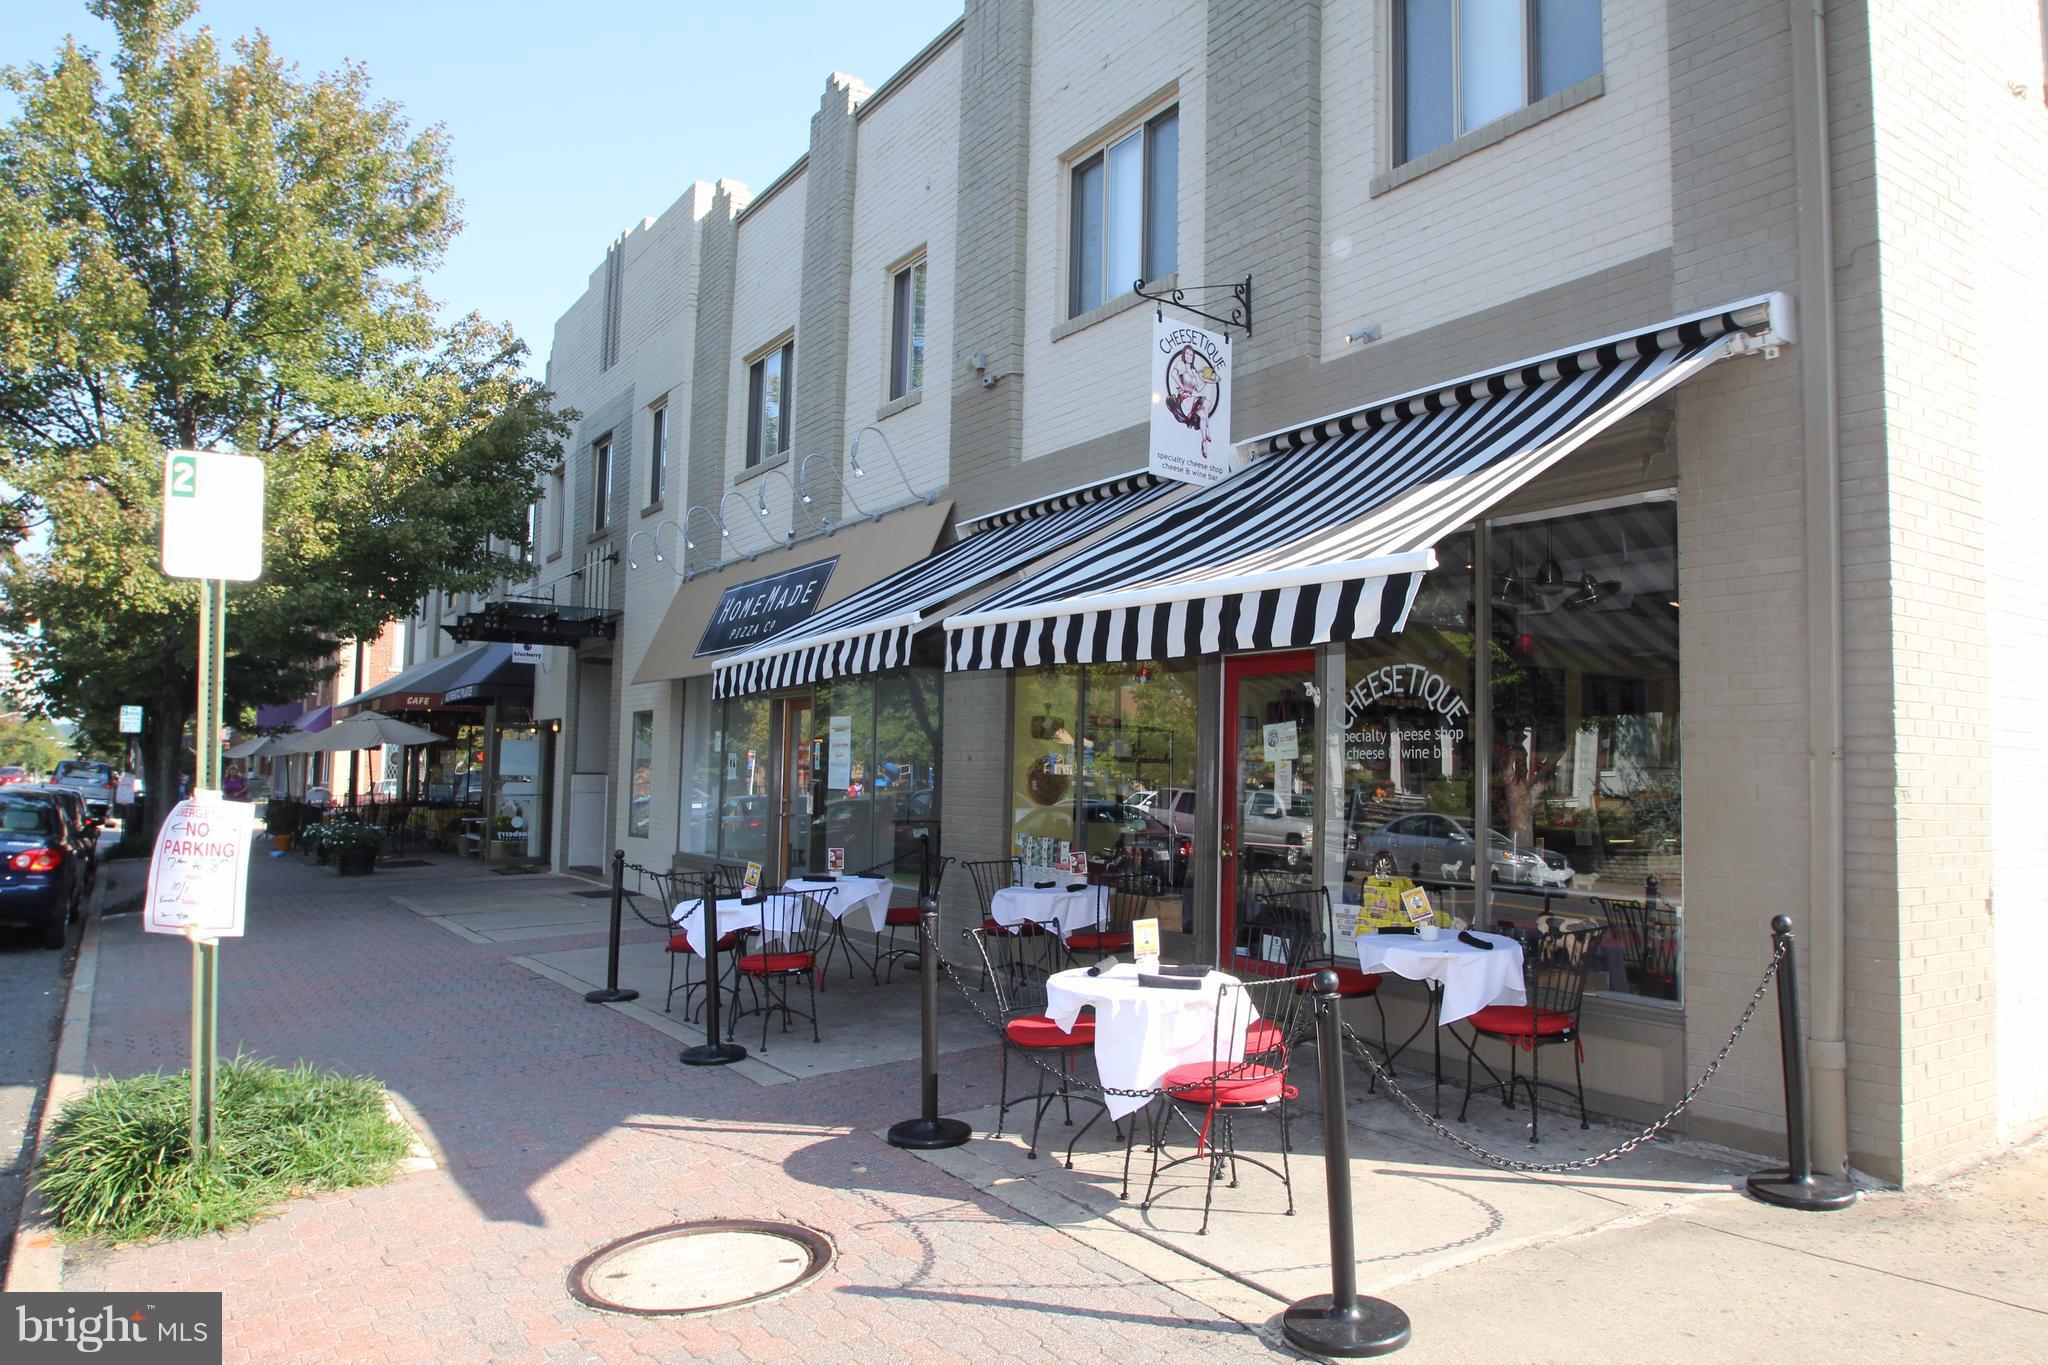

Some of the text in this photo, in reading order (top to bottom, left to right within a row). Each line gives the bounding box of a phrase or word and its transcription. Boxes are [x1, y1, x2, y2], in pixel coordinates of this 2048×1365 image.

[1159, 328, 1227, 371] CHEESETIQUE
[1157, 452, 1224, 475] specialty cheese shop
[1161, 462, 1184, 473] cheese
[1192, 470, 1207, 479] wine
[1208, 473, 1218, 481] bar
[173, 461, 194, 492] 2
[728, 624, 759, 640] PIZZA
[406, 696, 431, 705] CAFE
[1333, 662, 1470, 730] CHEESETIQUE
[1336, 728, 1387, 745] pecialty
[1434, 726, 1464, 743] shop
[1346, 746, 1385, 760] cheese
[1401, 745, 1430, 759] wine
[185, 821, 210, 838] NO
[163, 839, 235, 858] PARKING
